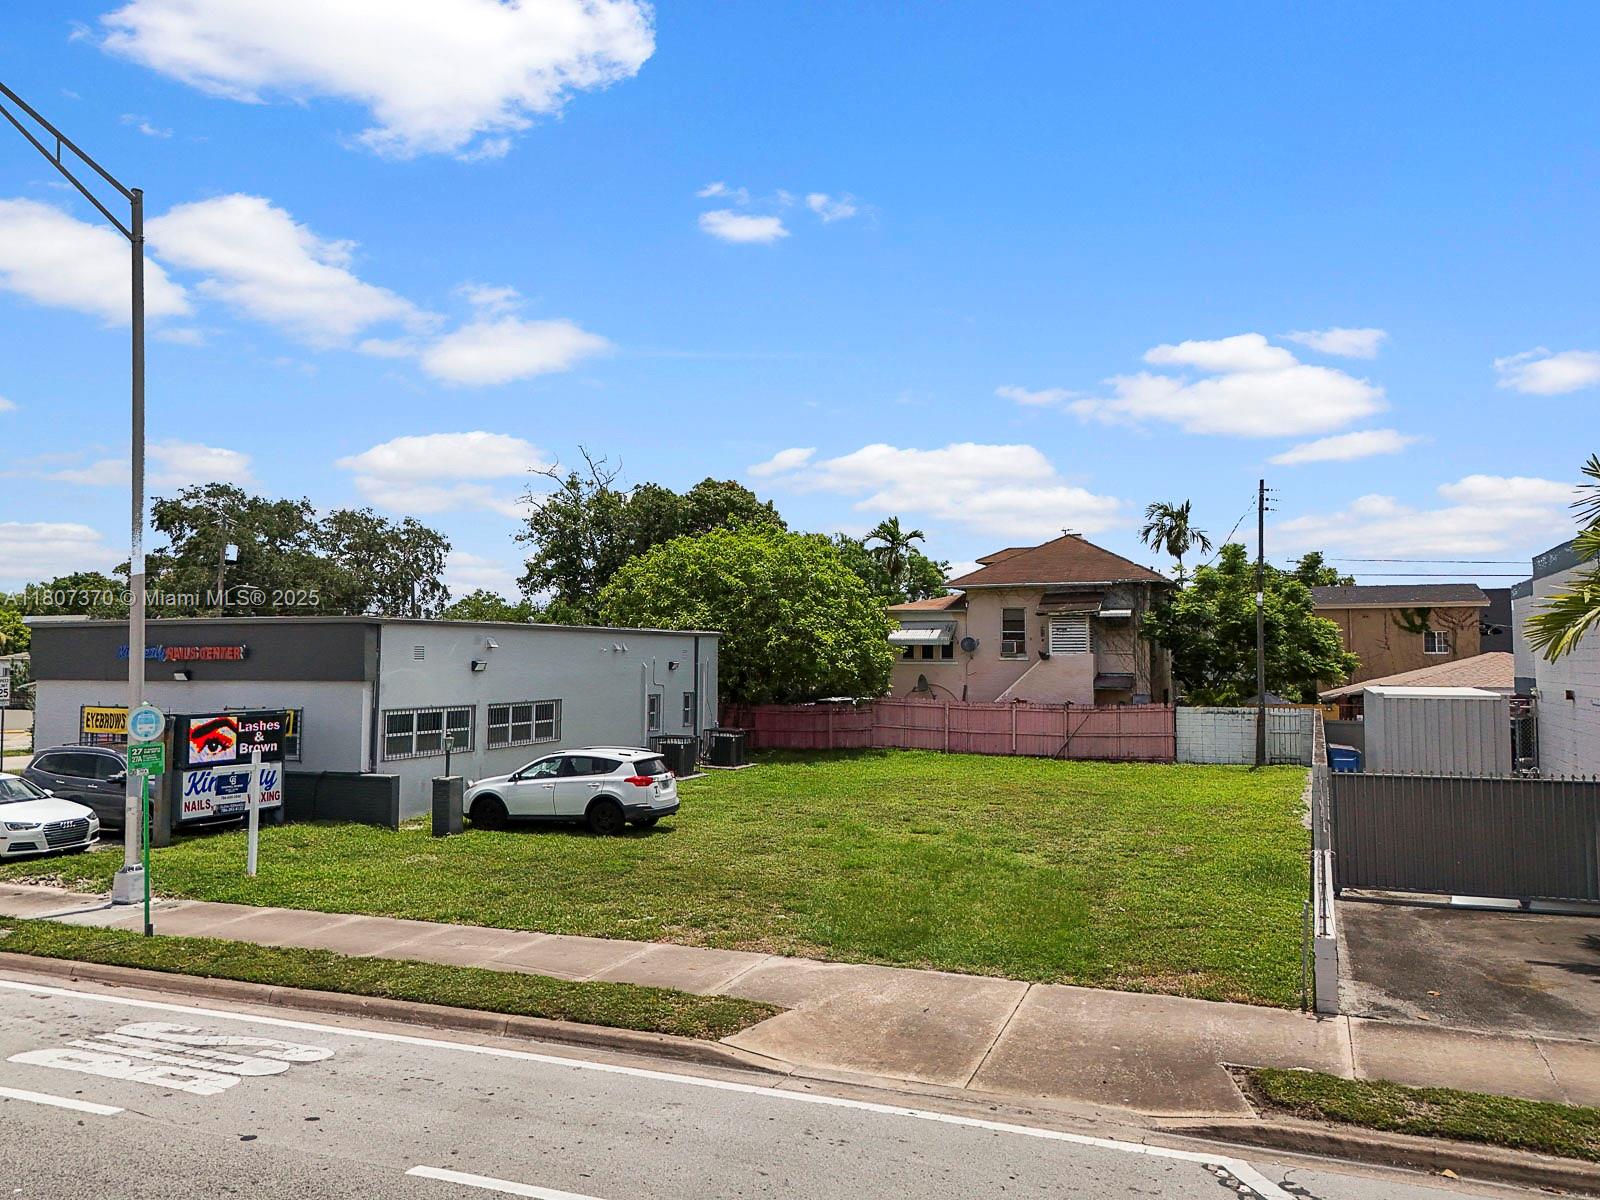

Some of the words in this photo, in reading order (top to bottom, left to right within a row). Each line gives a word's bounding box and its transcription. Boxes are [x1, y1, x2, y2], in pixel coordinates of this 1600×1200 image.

[86, 712, 126, 729] EYEBROWS
[238, 720, 281, 732] Lashes
[254, 731, 265, 742] &
[131, 748, 143, 756] 27
[239, 742, 278, 754] Brown
[247, 790, 280, 804] XING
